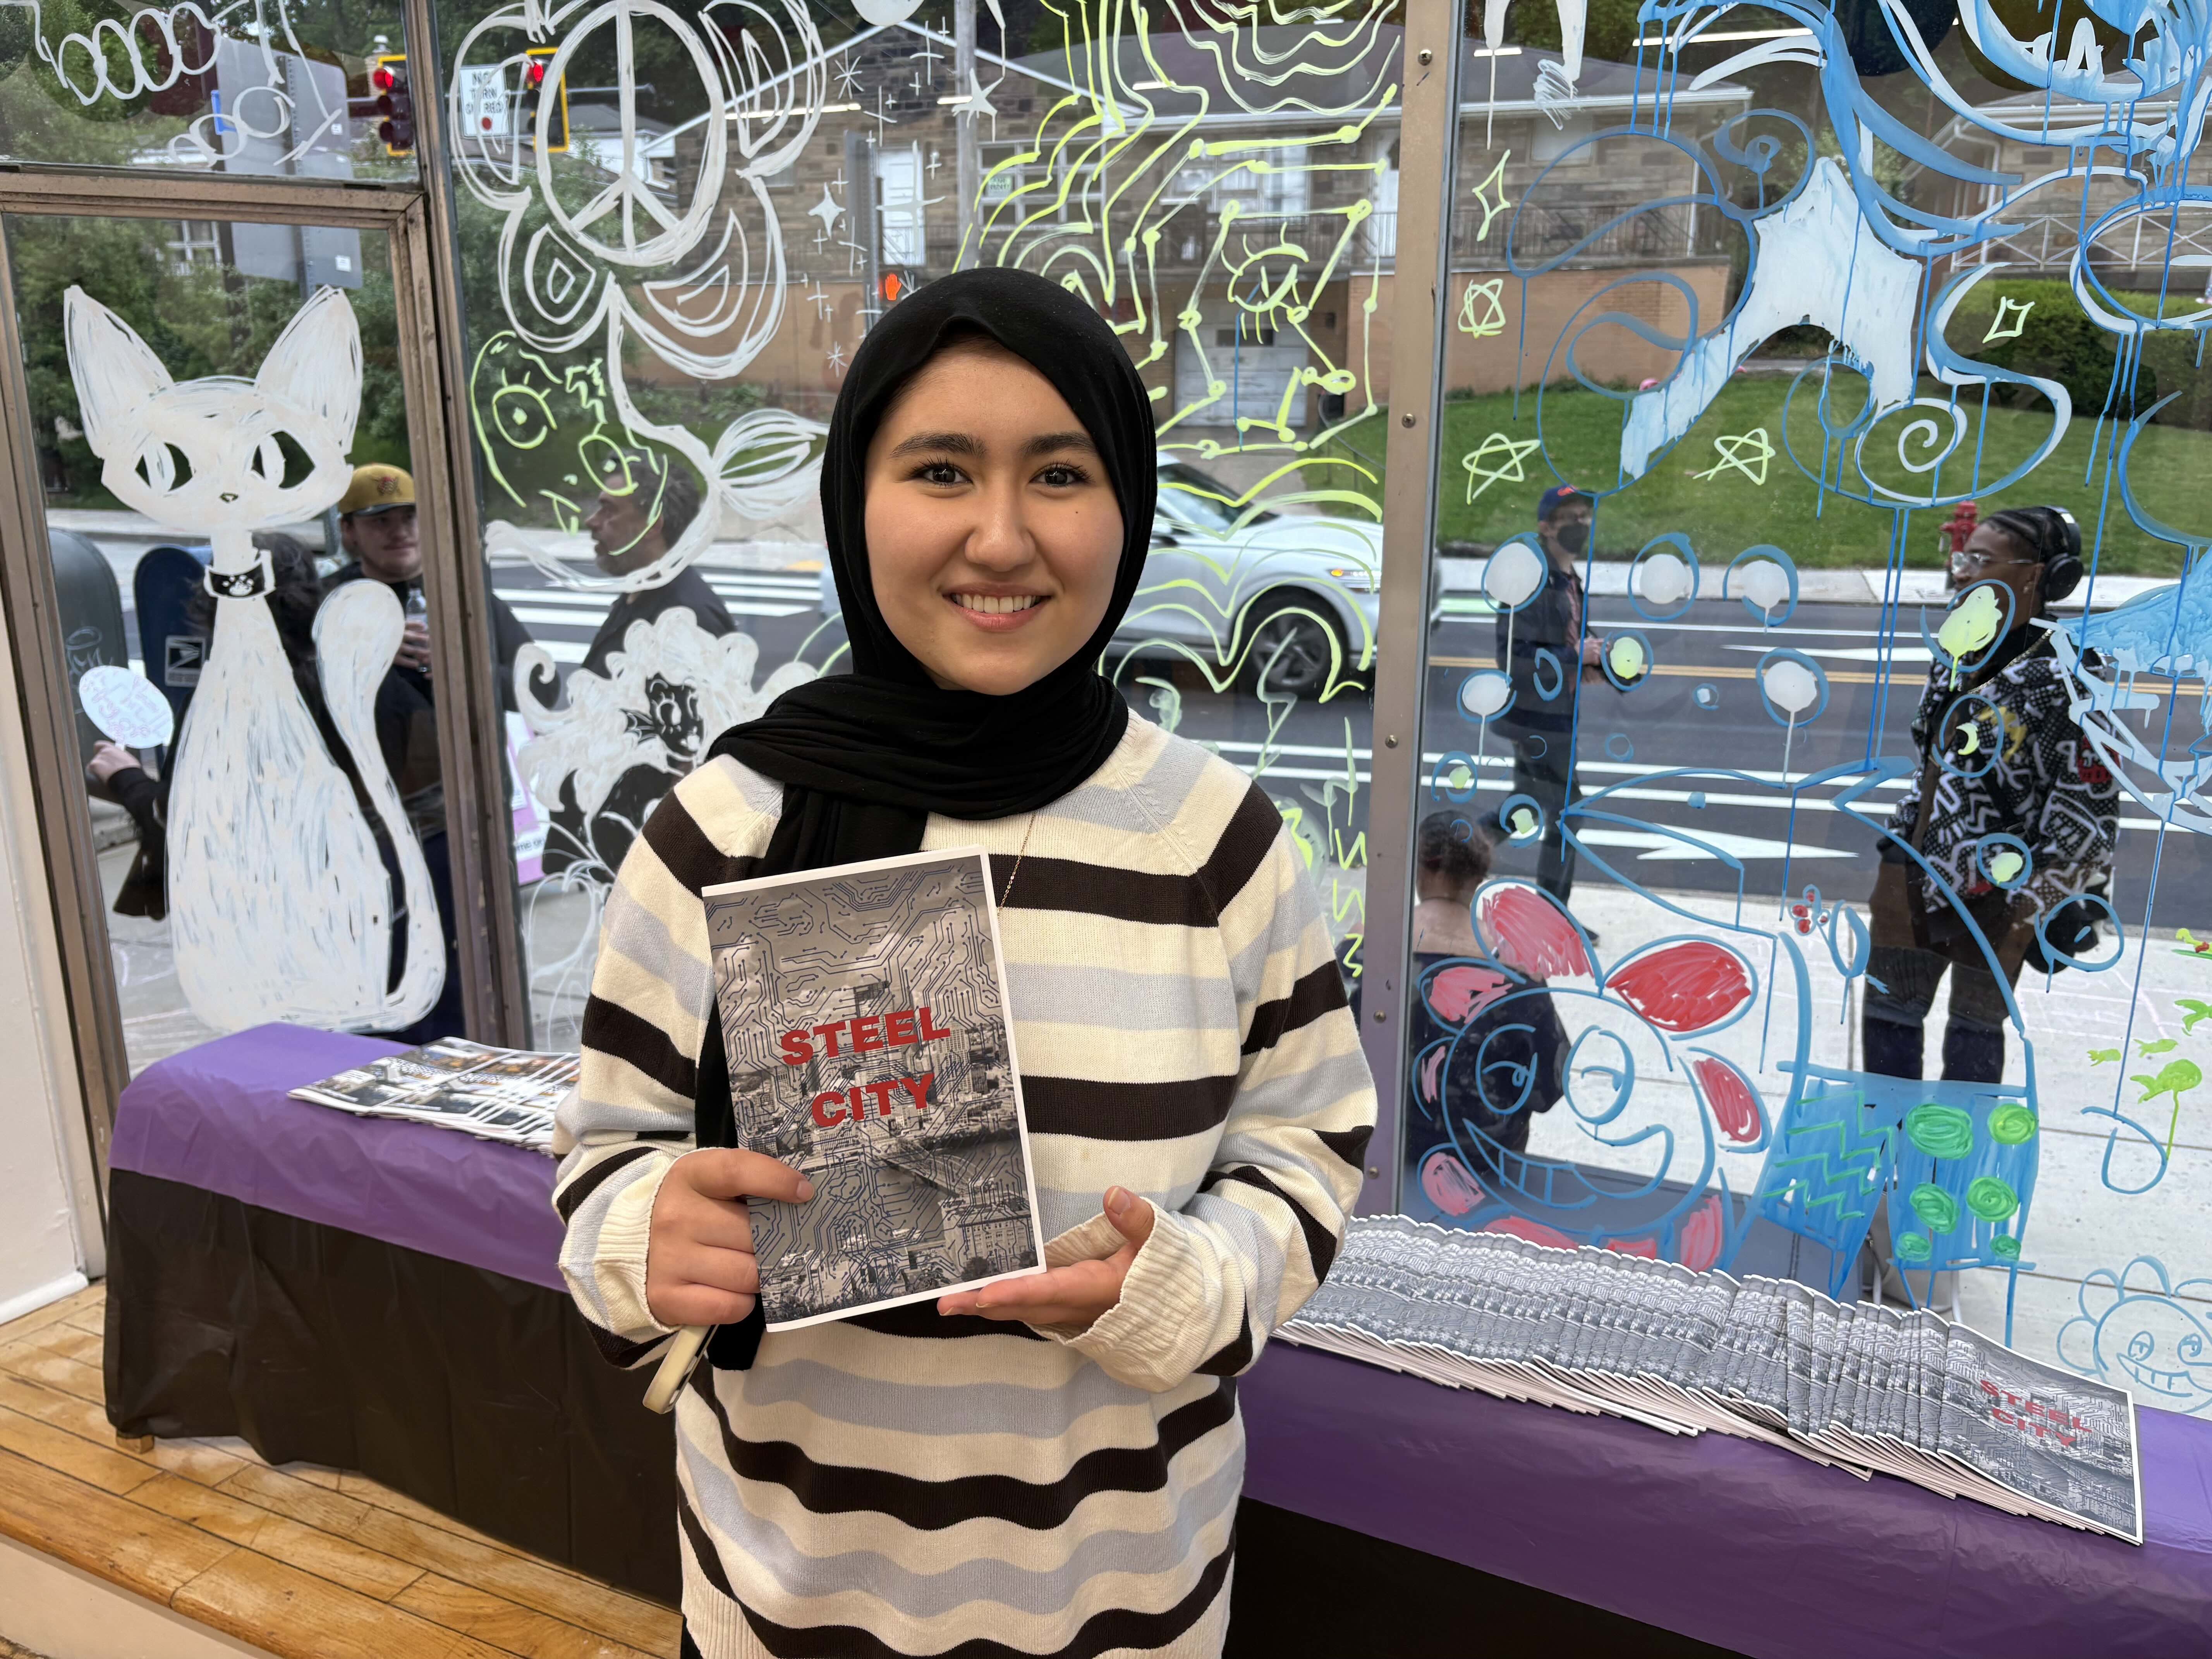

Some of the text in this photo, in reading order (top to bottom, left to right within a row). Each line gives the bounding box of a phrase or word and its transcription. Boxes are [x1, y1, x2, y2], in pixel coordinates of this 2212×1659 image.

[470, 88, 497, 99] TRN
[472, 72, 492, 85] NO
[484, 101, 503, 113] RED
[781, 1007, 951, 1065] STEEL
[812, 1073, 935, 1127] CITY
[1980, 1379, 2092, 1433] STEEL
[1992, 1408, 2076, 1446] CITY
